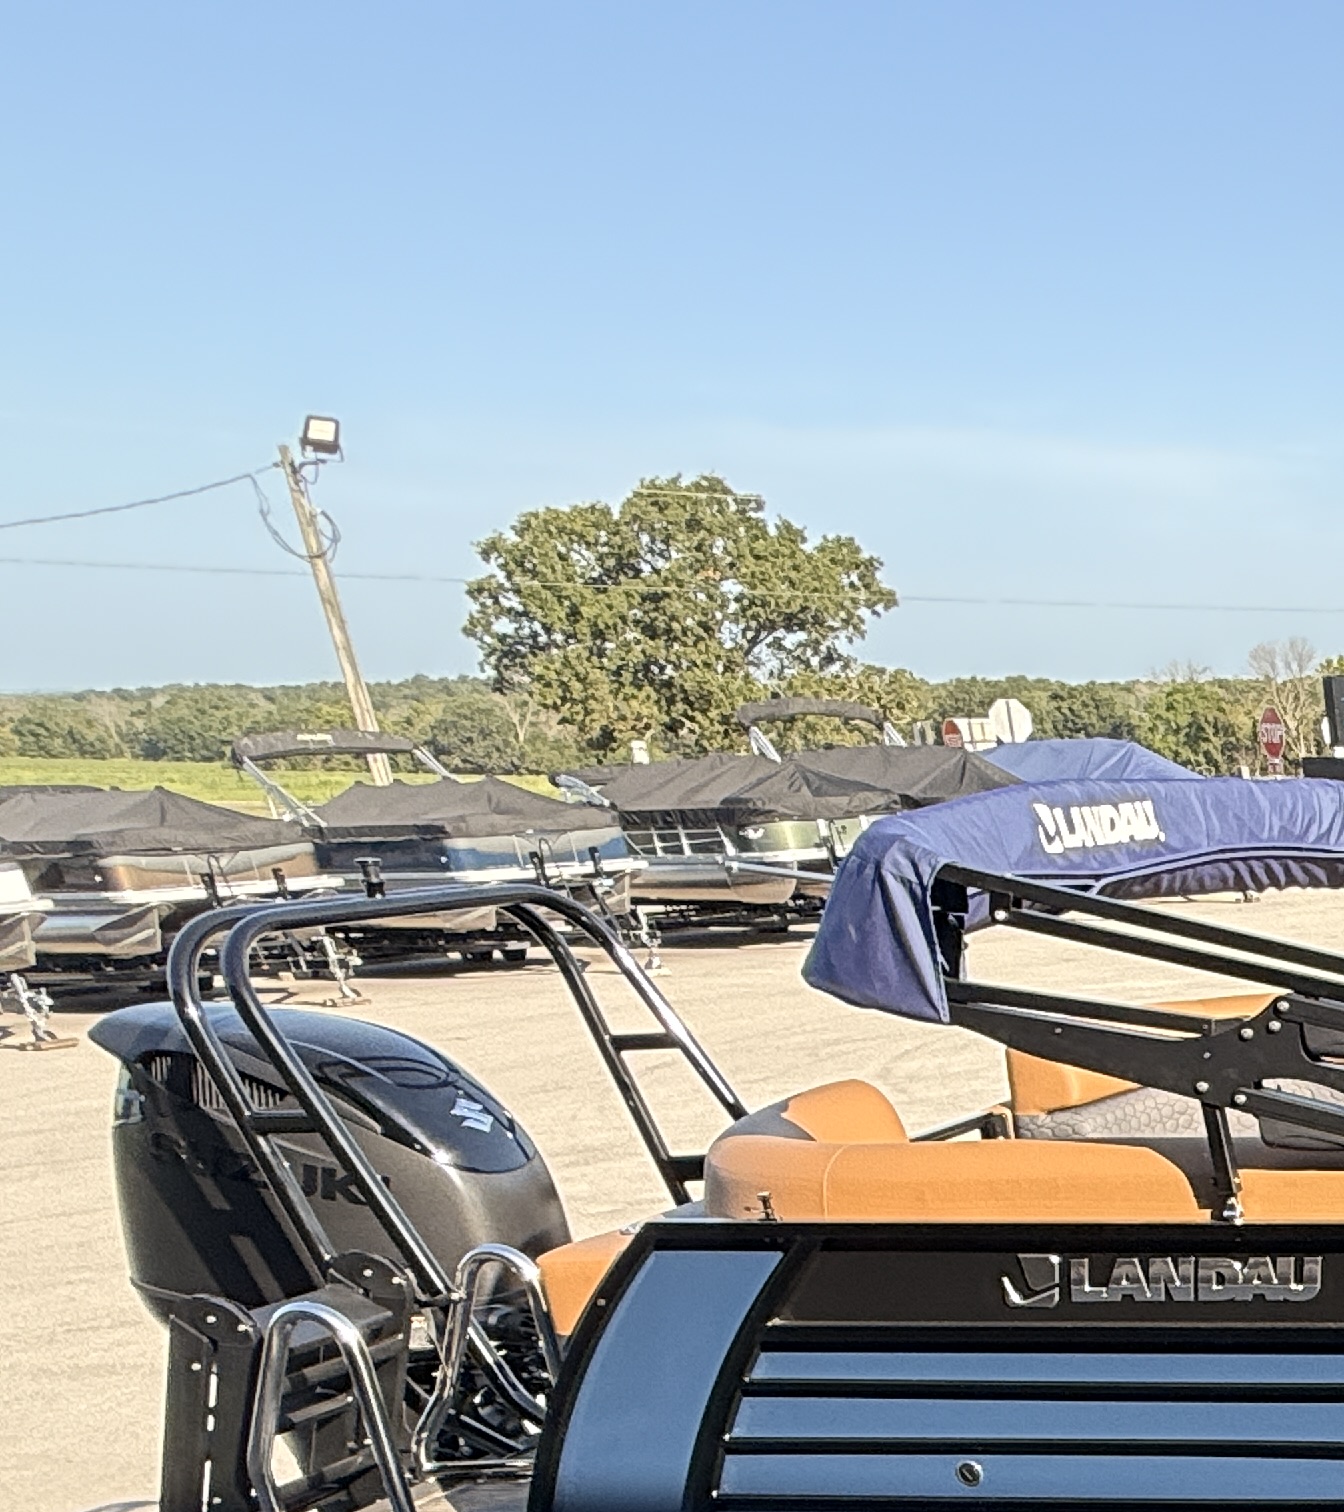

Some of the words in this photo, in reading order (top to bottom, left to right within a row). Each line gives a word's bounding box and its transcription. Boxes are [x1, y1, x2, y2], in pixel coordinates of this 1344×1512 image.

[1260, 723, 1284, 744] STOP
[1051, 799, 1160, 849] LANDAU
[1069, 1256, 1323, 1303] LANDAU
